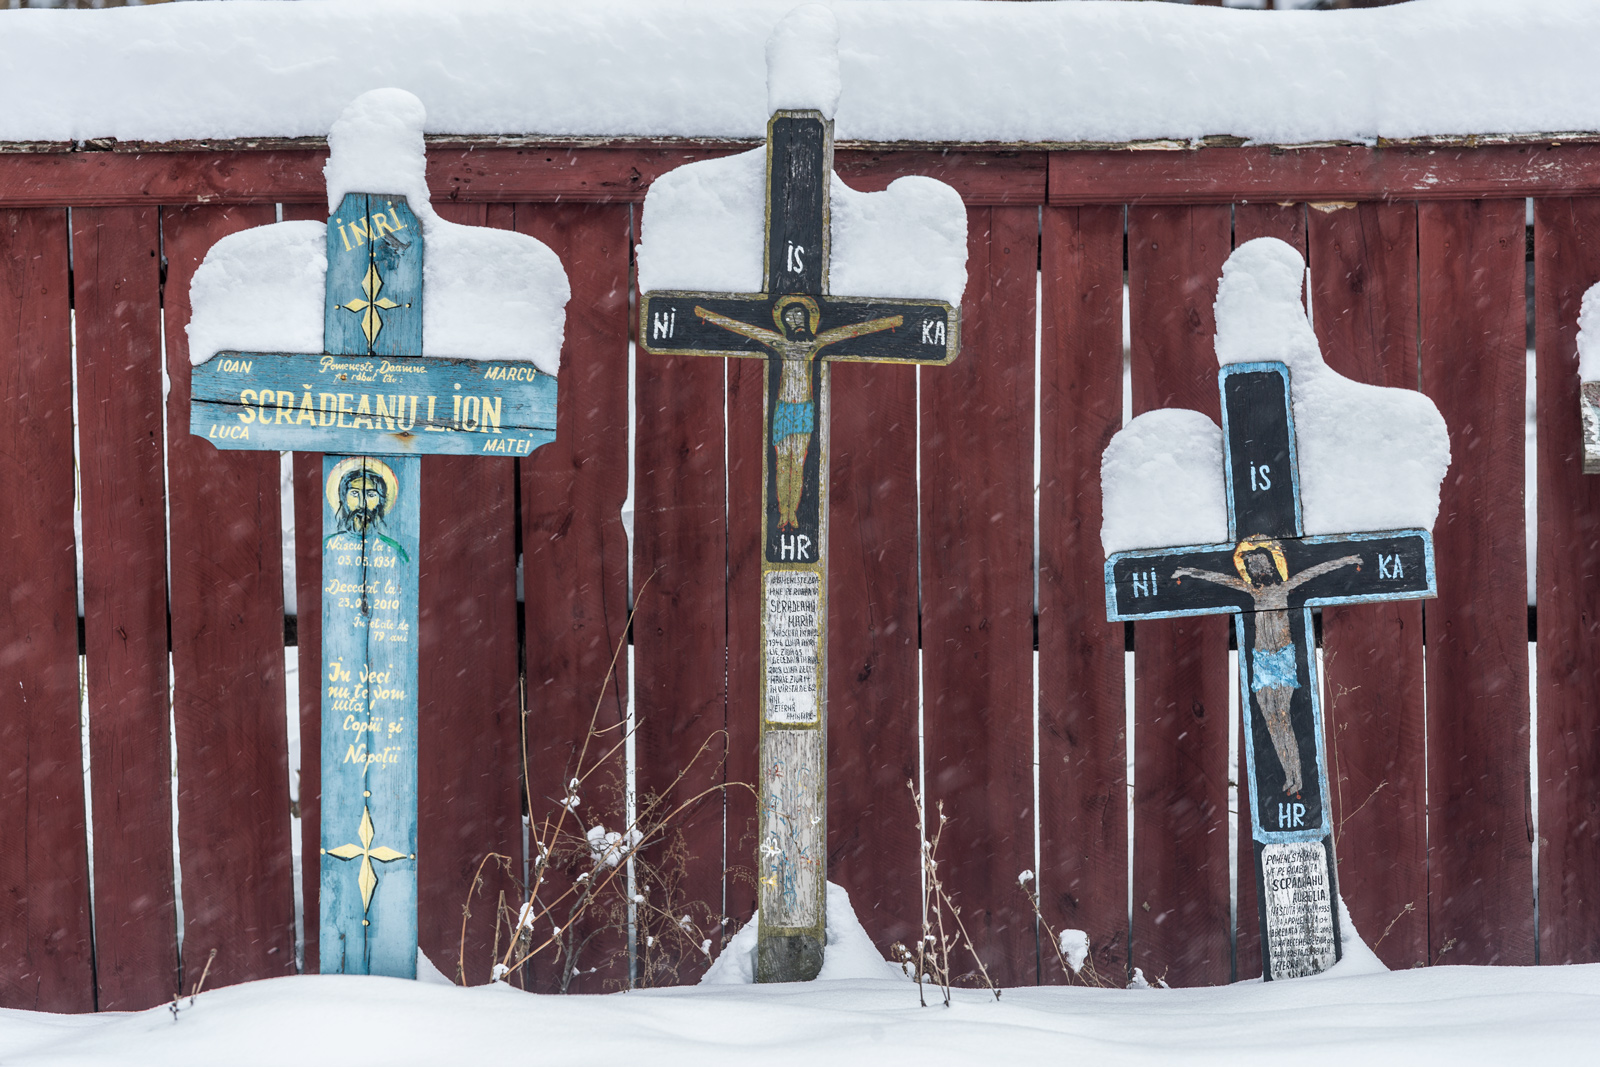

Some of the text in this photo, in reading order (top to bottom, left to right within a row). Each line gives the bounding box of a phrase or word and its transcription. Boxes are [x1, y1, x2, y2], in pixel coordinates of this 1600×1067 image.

[921, 320, 946, 346] KA
[216, 359, 253, 374] IOAN
[484, 366, 536, 382] MARCU
[238, 383, 419, 431] SCRĂDEANU
[209, 424, 251, 440] LUCA
[780, 534, 812, 560] HR
[1378, 553, 1404, 580] KA
[338, 597, 399, 609] 23.0.2010
[373, 631, 385, 642] 79
[359, 664, 393, 683] veci
[328, 683, 407, 700] nu te vom
[1278, 802, 1306, 829] HR
